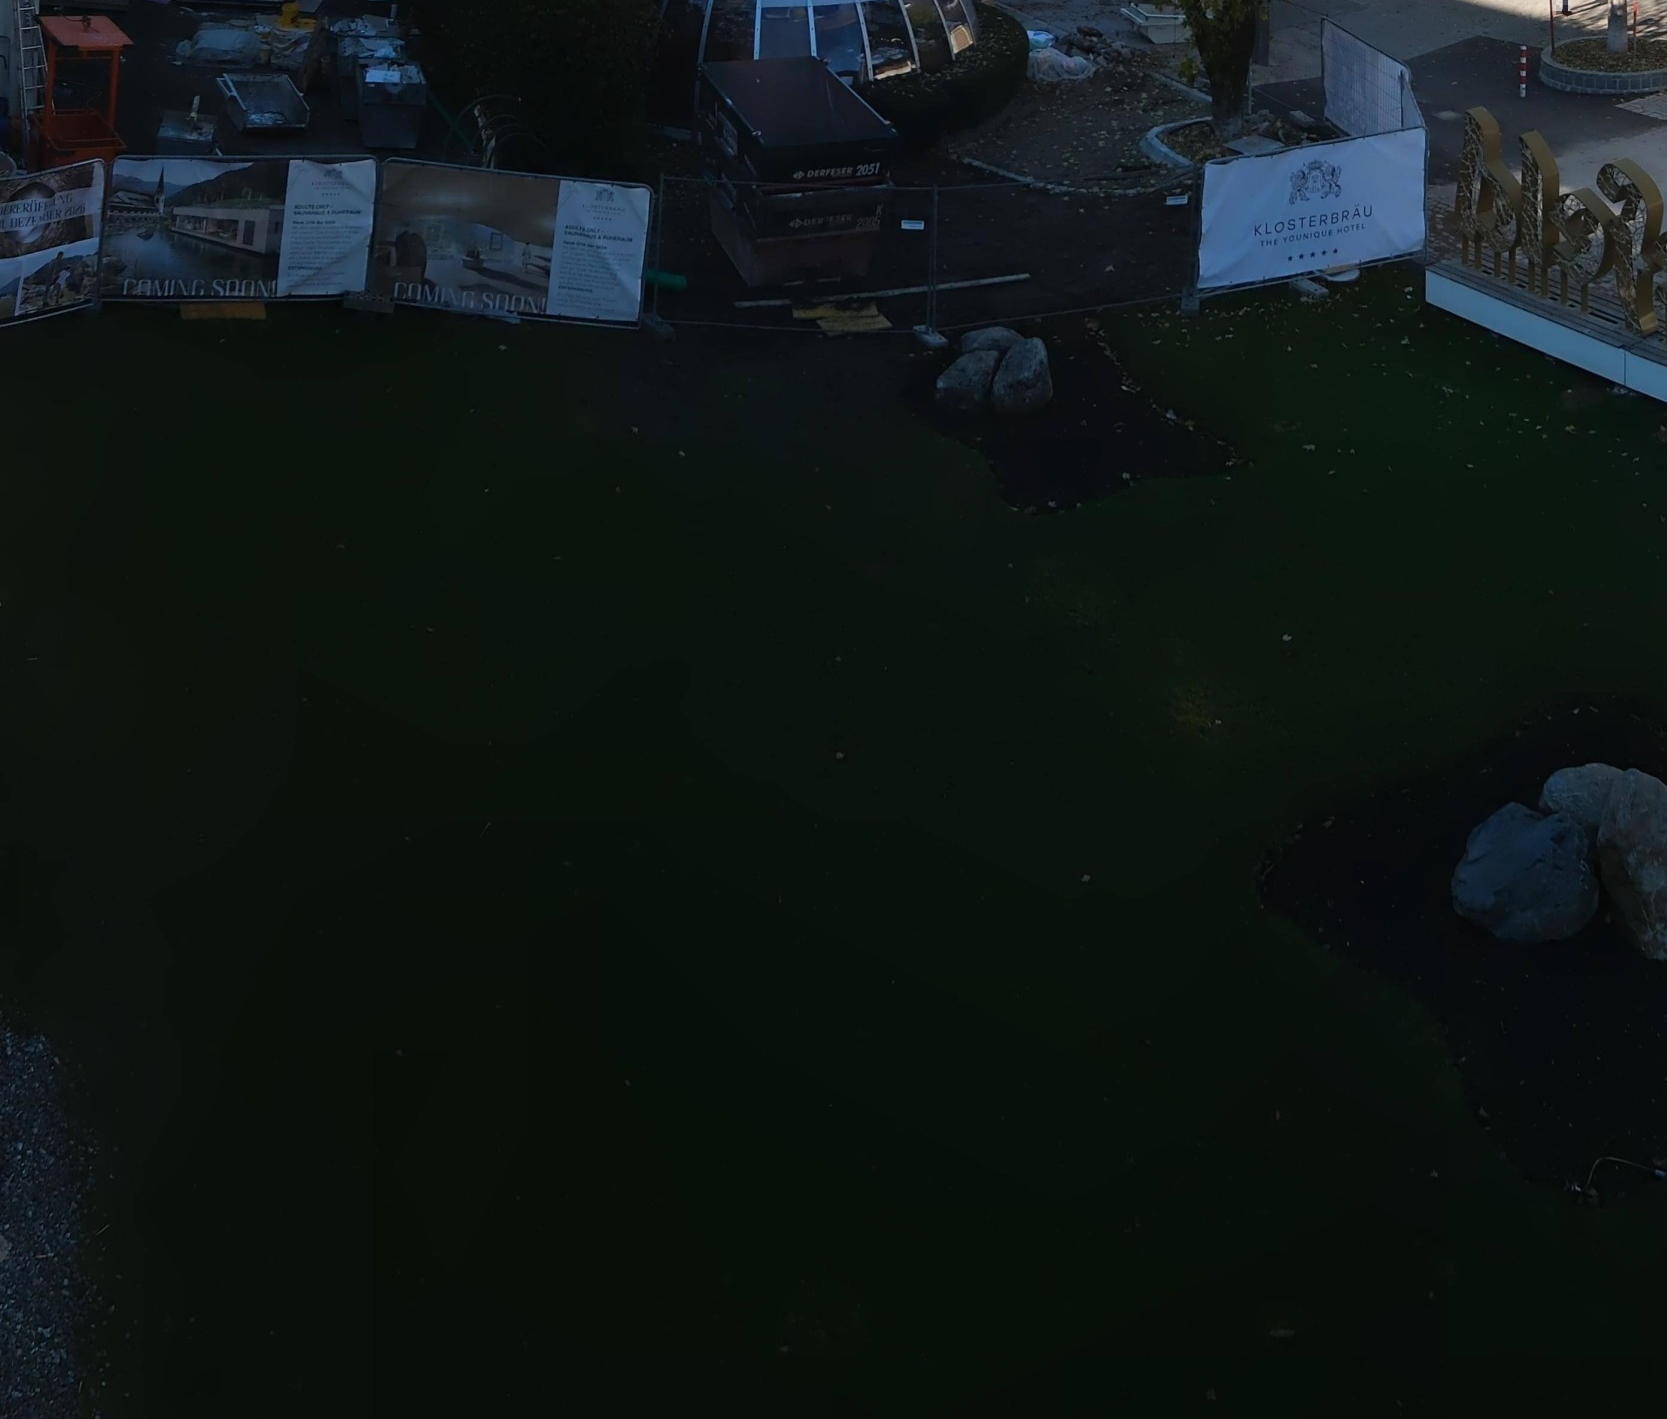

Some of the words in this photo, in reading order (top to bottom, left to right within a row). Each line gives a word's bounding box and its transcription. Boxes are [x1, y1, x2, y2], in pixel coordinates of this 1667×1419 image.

[806, 167, 852, 178] DERFESER
[855, 162, 881, 177] 2051
[1253, 204, 1374, 237] KLOSTERBRÄU
[1260, 238, 1278, 247] THE
[1282, 229, 1333, 244] YOUNIQUE
[1336, 223, 1366, 236] HOTEL
[122, 277, 205, 298] COMING
[393, 281, 475, 309] COMING
